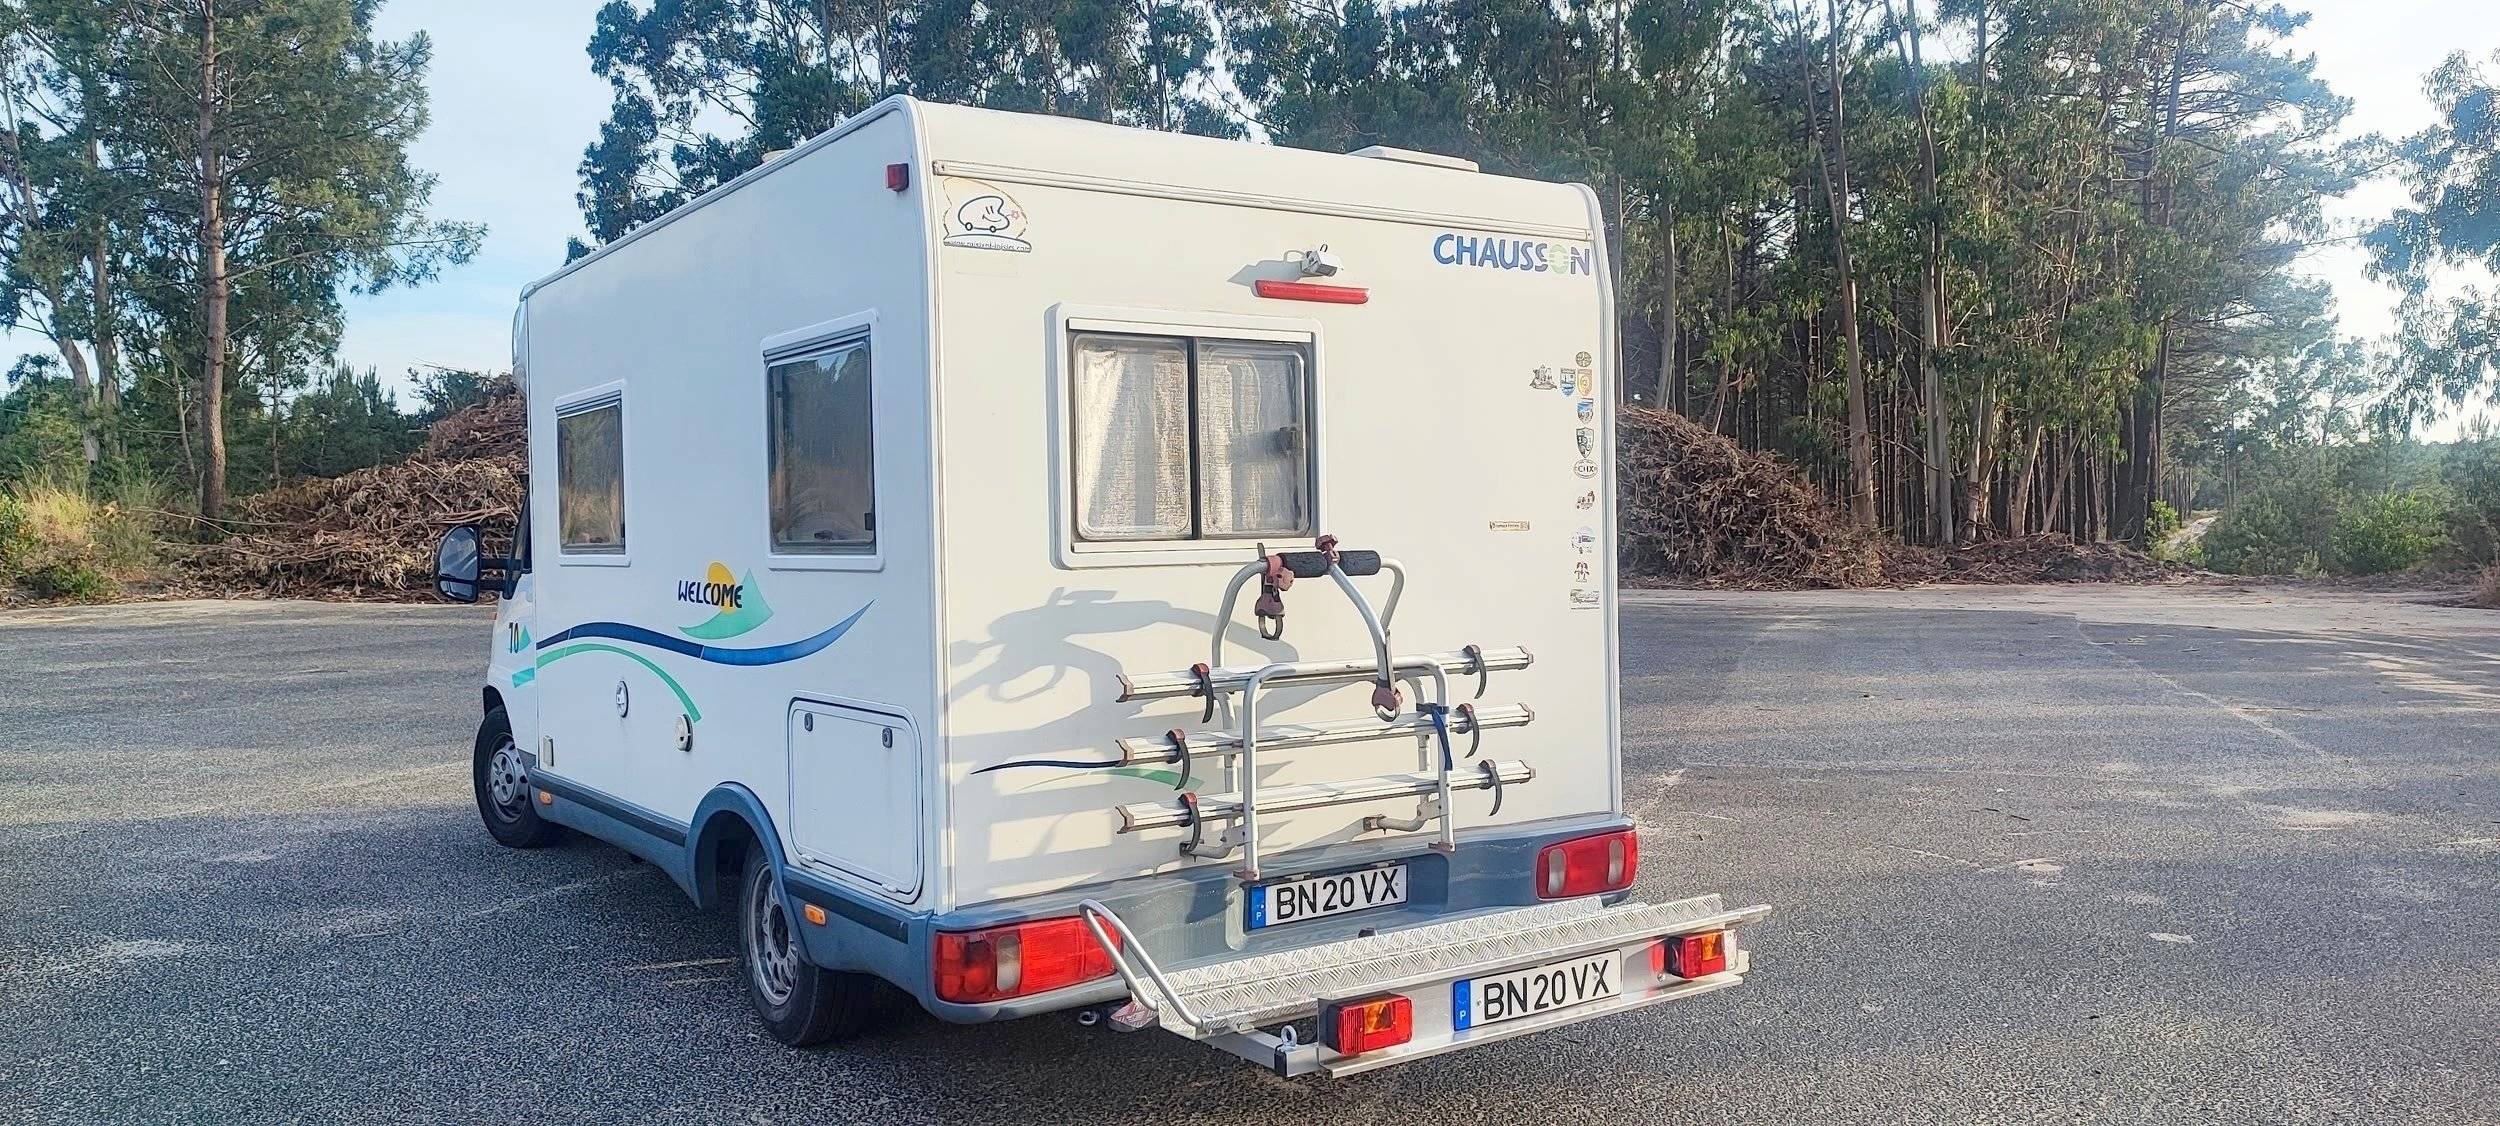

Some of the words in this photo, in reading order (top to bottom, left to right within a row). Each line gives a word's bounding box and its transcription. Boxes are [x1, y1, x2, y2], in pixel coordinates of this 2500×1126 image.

[1433, 233, 1590, 276] CHAUSSON
[678, 580, 743, 608] WELCOME
[509, 622, 519, 653] 10
[1459, 1010, 1467, 1021] P
